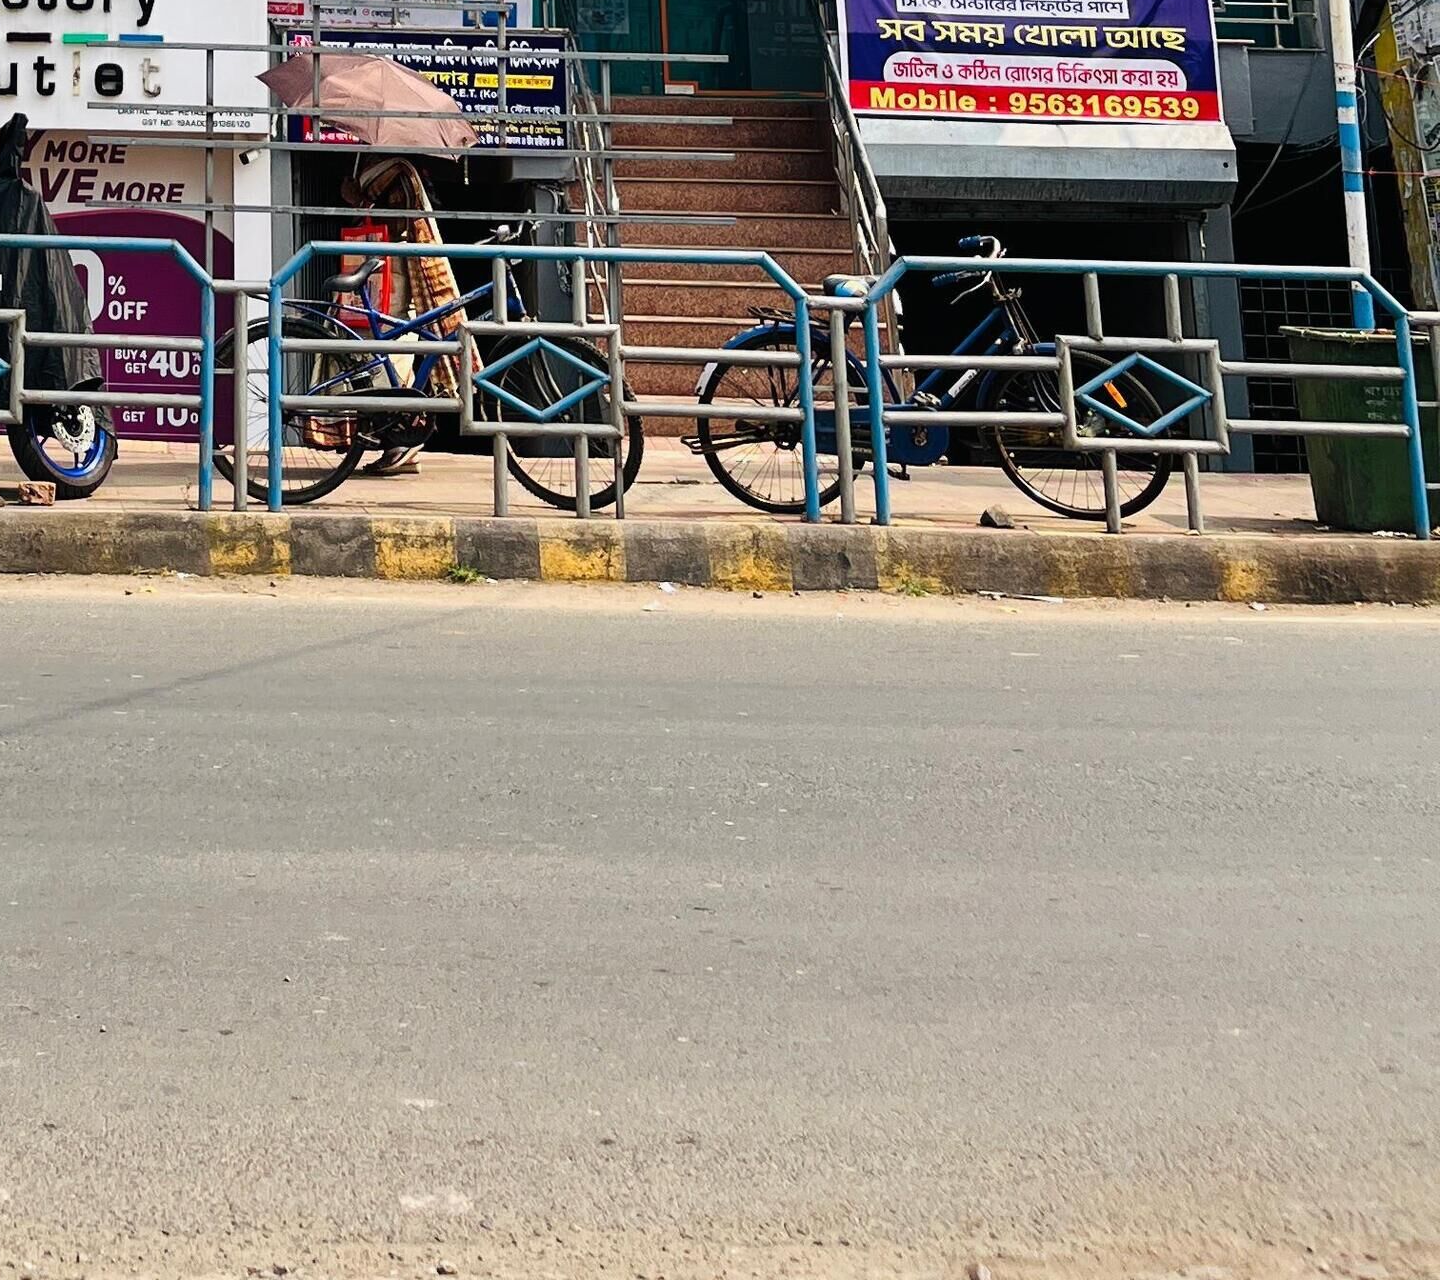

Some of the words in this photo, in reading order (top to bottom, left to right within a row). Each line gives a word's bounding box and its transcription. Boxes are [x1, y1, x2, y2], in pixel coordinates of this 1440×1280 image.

[1087, 0, 1124, 14] পাশে
[876, 18, 926, 43] সব
[935, 19, 1005, 48] সময়
[1013, 22, 1097, 49] খোলা
[1103, 25, 1187, 52] আছে
[892, 57, 938, 80] জটিল
[941, 63, 953, 79] ও
[958, 59, 1000, 82] কঠিন
[1004, 66, 1054, 84] রোগের
[1057, 62, 1118, 87] চিকিৎসা
[1122, 70, 1153, 86] করা
[1157, 70, 1179, 88] হয়
[869, 86, 977, 112] Mobile
[988, 94, 997, 112] :
[1008, 92, 1200, 119] 9563169539
[44, 140, 128, 165] MORE
[101, 183, 185, 204] MORE
[108, 275, 127, 296] %
[107, 300, 149, 322] OFF
[114, 349, 138, 360] BUY
[139, 350, 148, 361] 4
[148, 350, 190, 378] 40
[124, 362, 148, 374] GET
[122, 410, 146, 423] GET
